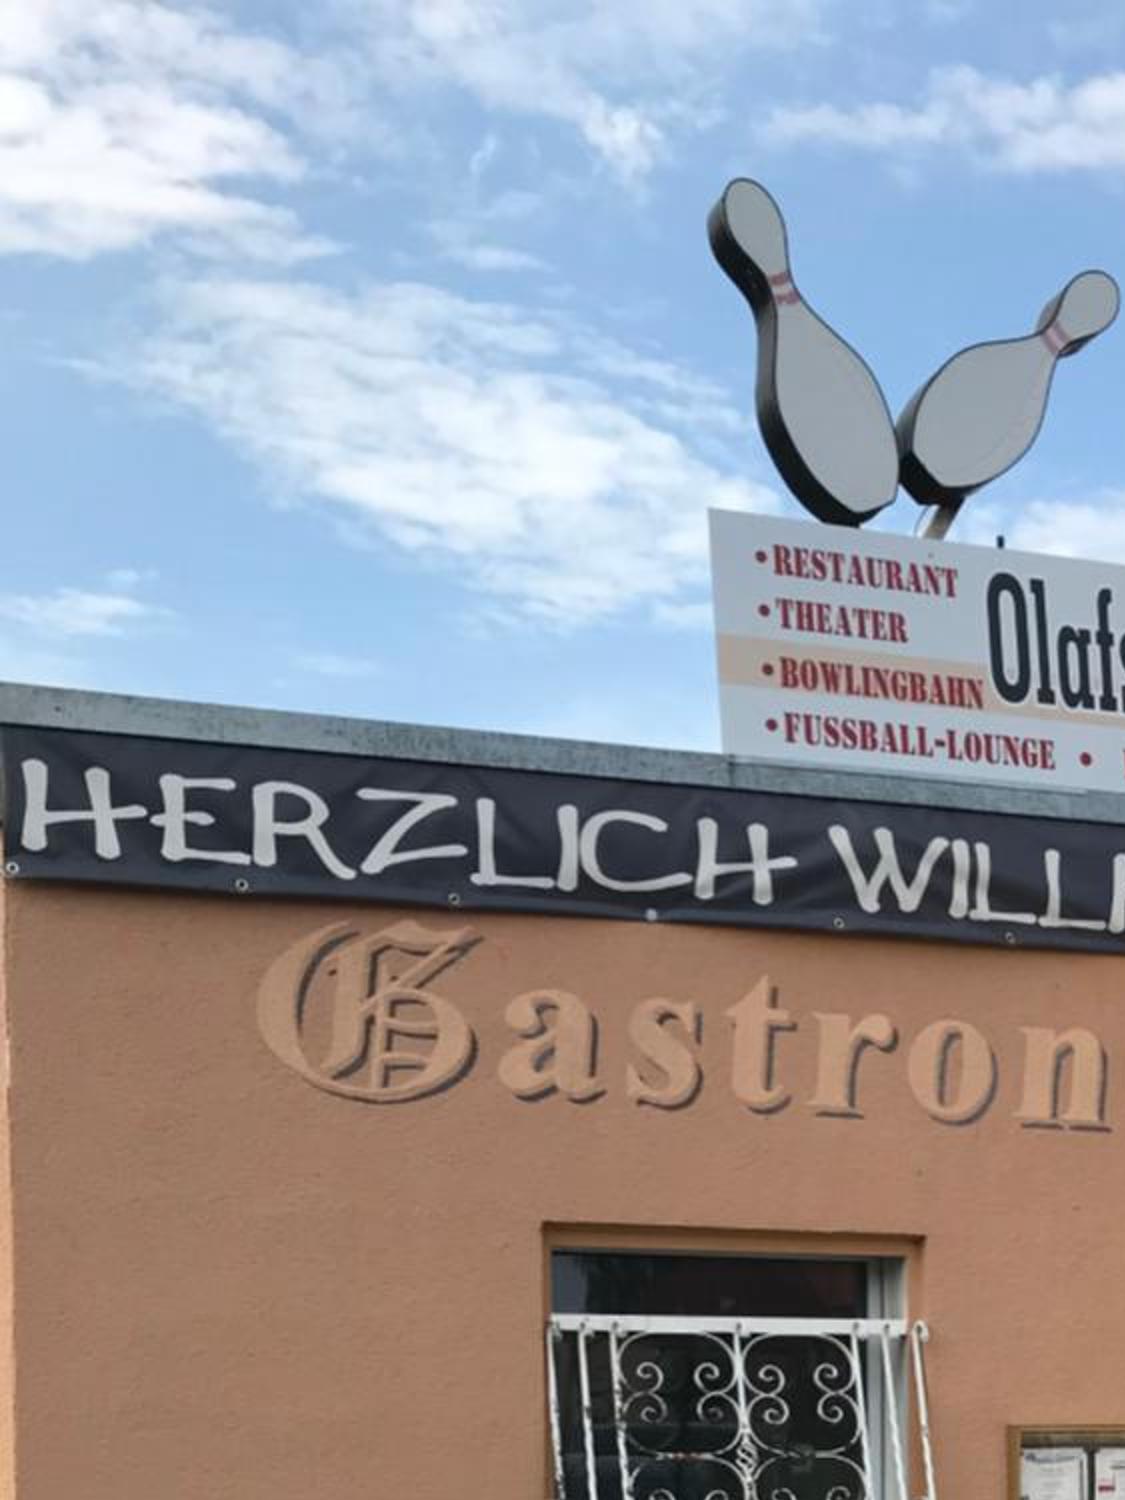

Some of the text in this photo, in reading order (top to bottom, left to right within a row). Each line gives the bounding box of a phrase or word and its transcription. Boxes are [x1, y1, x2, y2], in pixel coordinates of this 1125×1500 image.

[772, 544, 958, 598] RESTAURANT
[776, 598, 909, 643] THEATER
[780, 657, 984, 710] BOWLINGBAHN
[784, 712, 1057, 770] FUSSBALL-LOUNGE
[20, 757, 798, 905] HERZLICH
